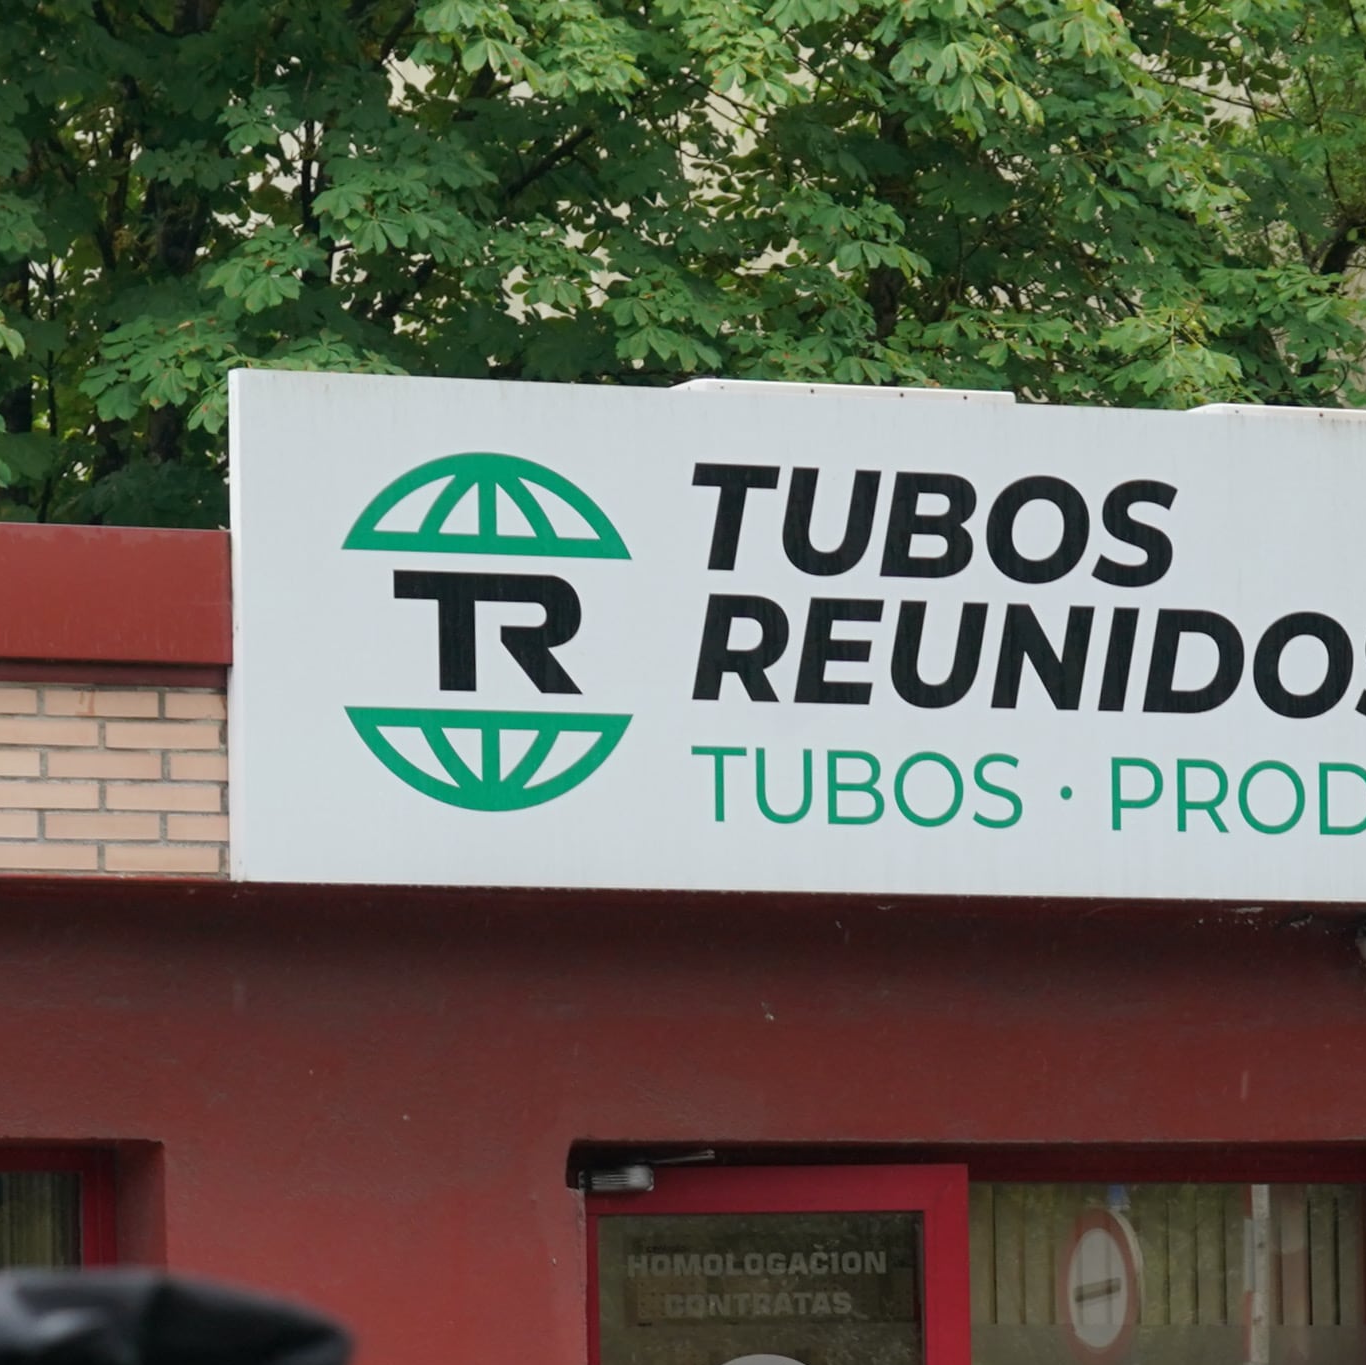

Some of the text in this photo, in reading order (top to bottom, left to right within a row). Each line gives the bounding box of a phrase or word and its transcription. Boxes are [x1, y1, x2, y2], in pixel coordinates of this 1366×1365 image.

[692, 462, 1180, 589] TUBOS
[393, 569, 584, 695] TR
[690, 745, 1025, 830] TUBOS
